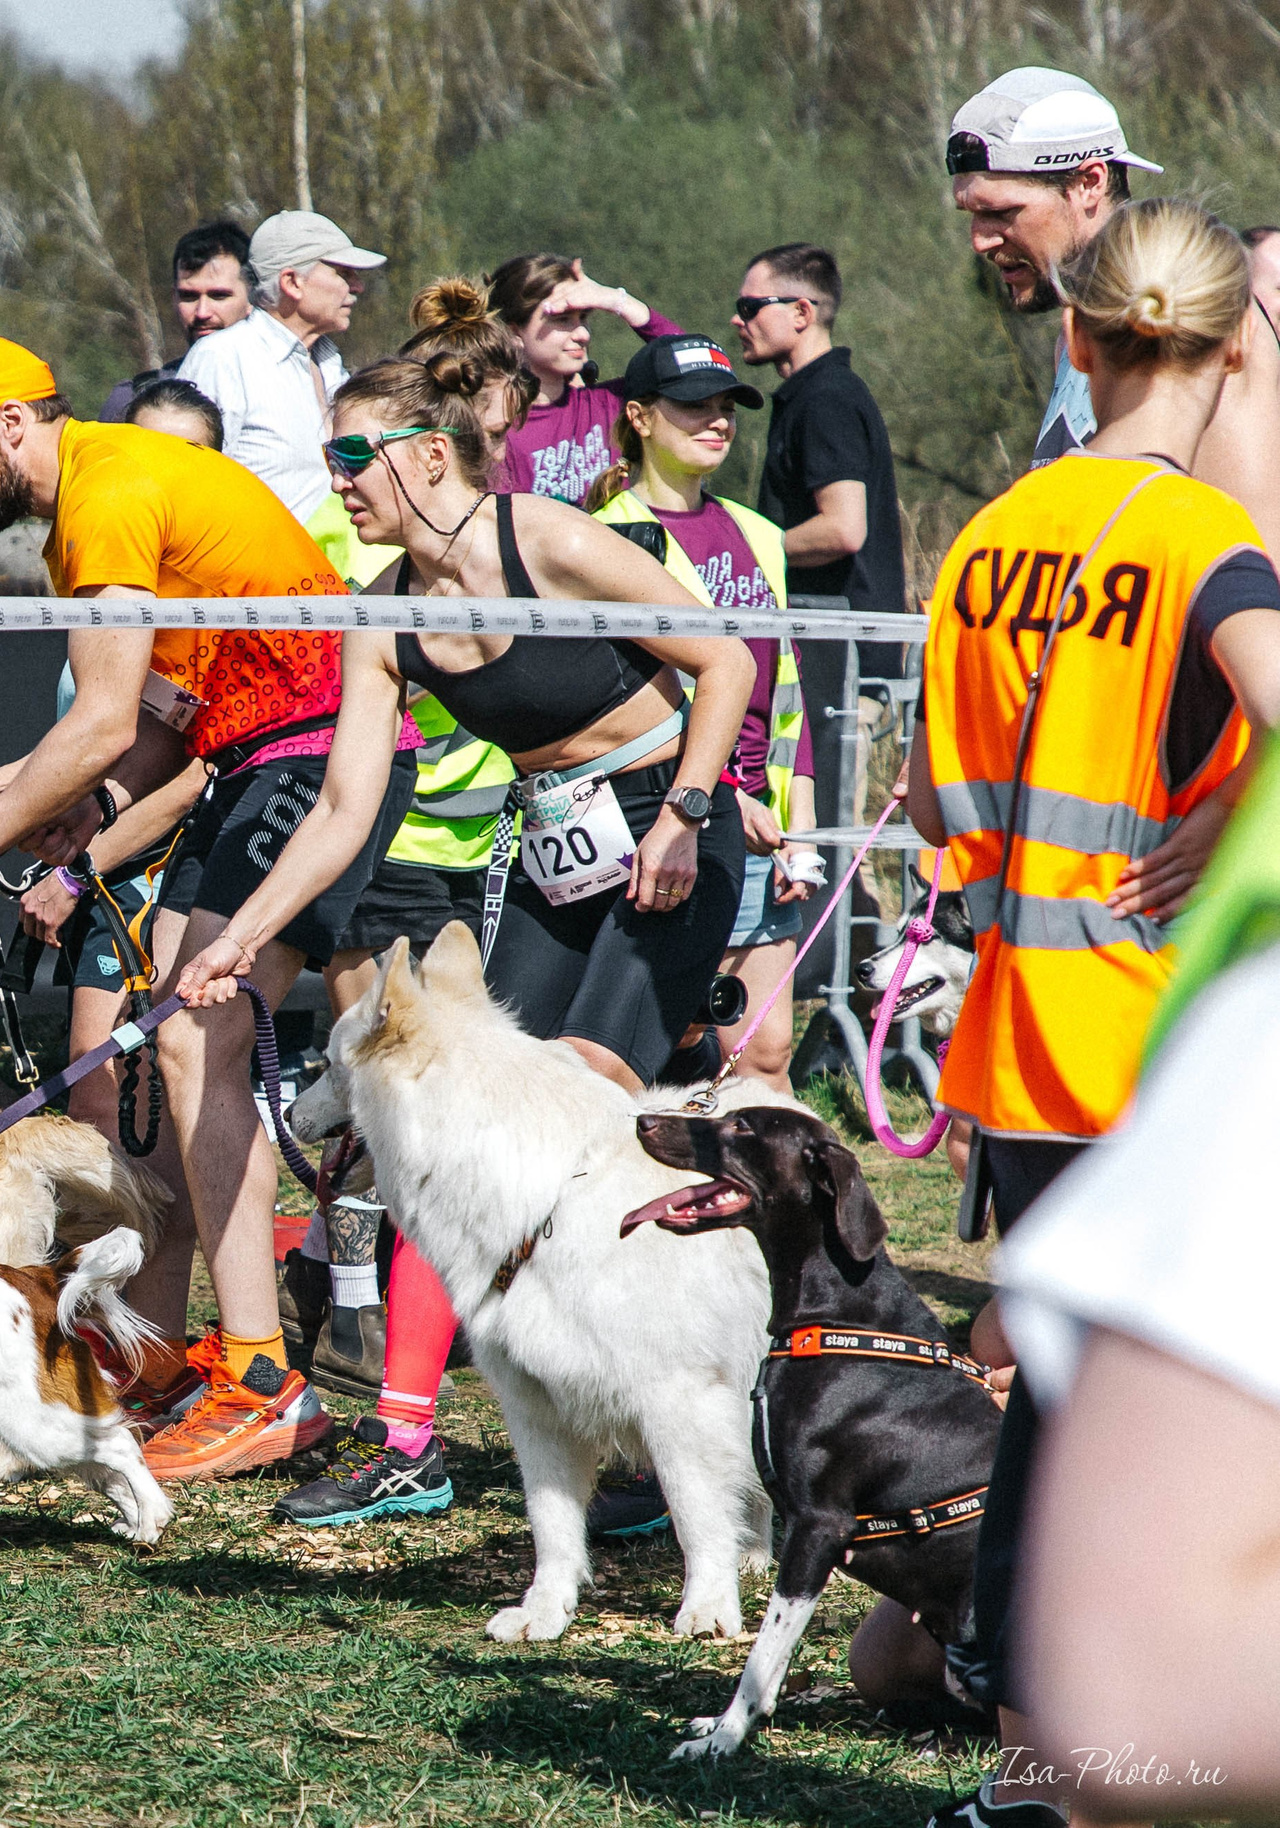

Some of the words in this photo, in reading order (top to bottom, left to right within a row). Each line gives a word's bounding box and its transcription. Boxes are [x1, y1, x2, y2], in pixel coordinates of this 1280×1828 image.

[954, 547, 1151, 649] СУДЬЯ
[529, 826, 598, 880] 120
[824, 1334, 859, 1349] staya
[872, 1338, 906, 1353] staya
[946, 1498, 981, 1516] staya
[867, 1519, 899, 1532] staya
